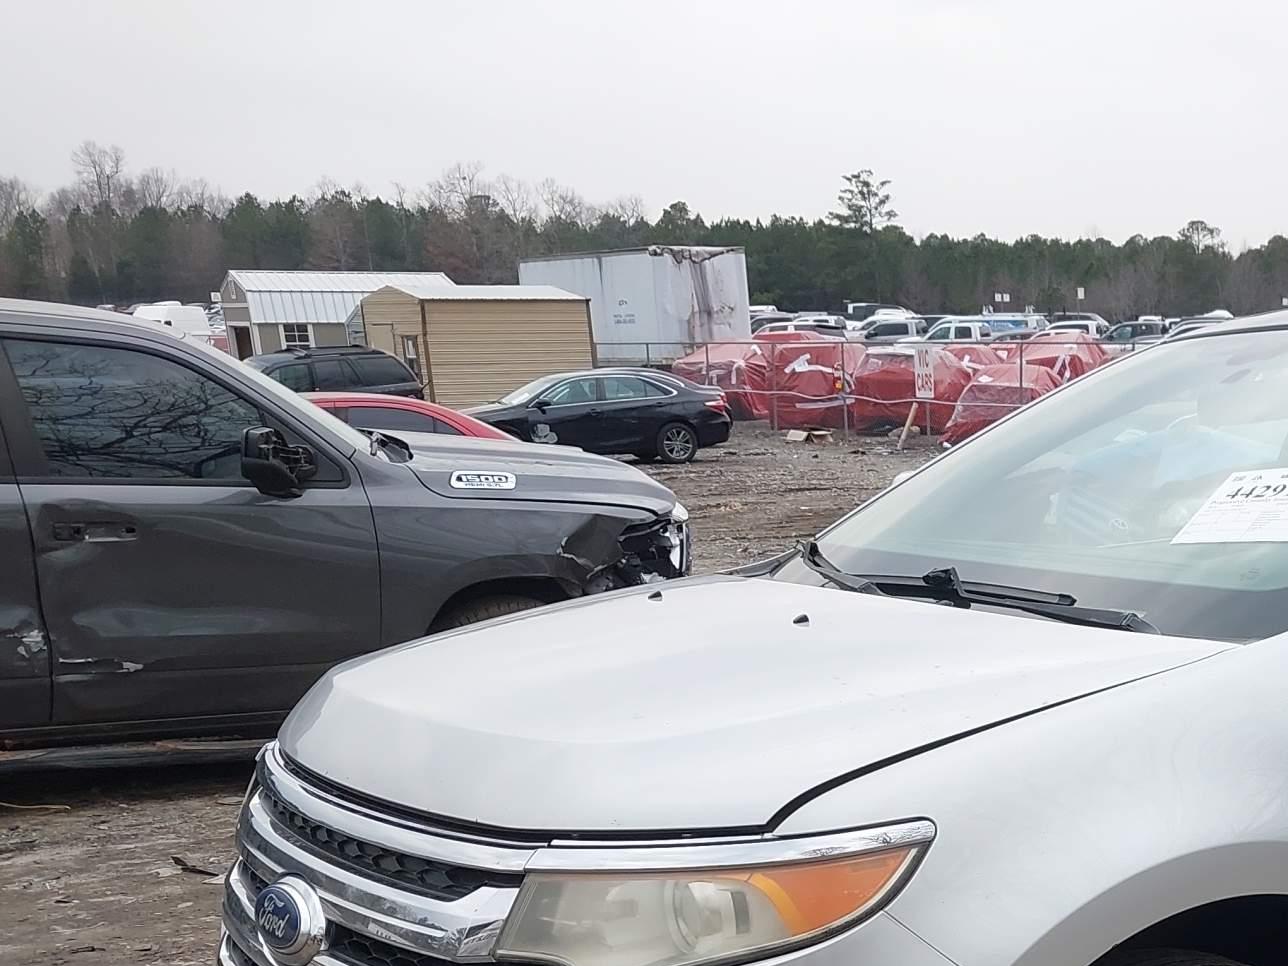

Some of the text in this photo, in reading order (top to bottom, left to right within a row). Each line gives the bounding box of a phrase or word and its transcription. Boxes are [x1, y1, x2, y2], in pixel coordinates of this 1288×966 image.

[916, 372, 933, 392] CARS
[458, 474, 509, 483] 1500
[259, 893, 290, 939] Ford
